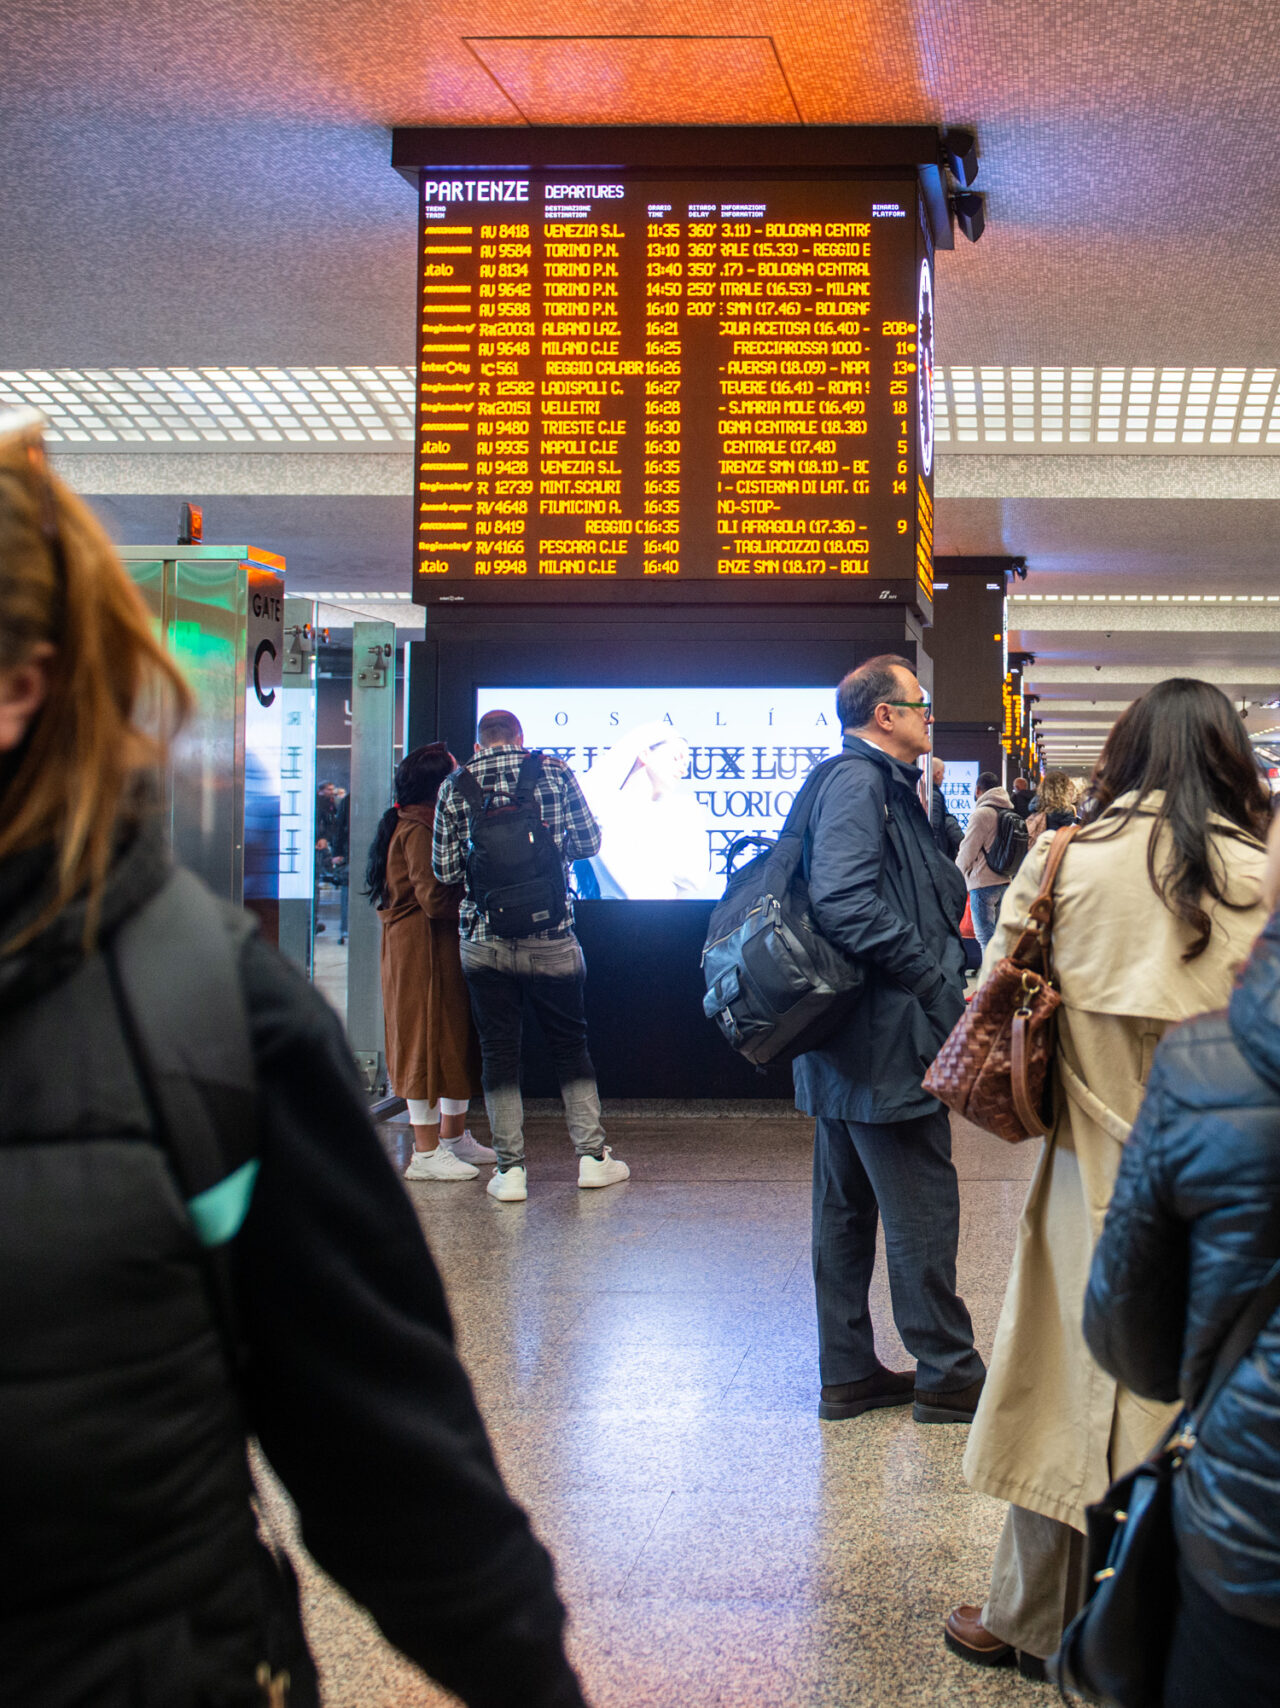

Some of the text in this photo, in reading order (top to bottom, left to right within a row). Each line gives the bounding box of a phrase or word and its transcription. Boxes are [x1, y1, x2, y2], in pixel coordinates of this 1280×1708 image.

[425, 181, 625, 201] PARTENZE DEPARTURES
[498, 223, 822, 238] 8418 VENEZIA S.L. 11:35 360' BOLOGNA
[500, 243, 860, 257] 9584 TORINO P.N. 13:10 360' (15.33) REGGIO
[498, 263, 529, 277] 8134
[544, 263, 590, 277] TORINO
[593, 263, 619, 277] P.N.
[647, 263, 683, 277] 13:40
[688, 263, 717, 277] 350'
[757, 263, 814, 277] BOLOGNA
[498, 282, 812, 297] 9642 TORINO P.N. 14:50 250' (16.53)
[497, 302, 802, 316] 9588 TORINO P.N. 16:10 200' SMN (17.46)
[496, 322, 907, 336] 20031 ALBANO LAZ. 16:21 ACETOSA (16.40) 20B
[496, 341, 907, 355] 9648 MILANO C.LE 16:25 FRECCIAROSSA 1000 11
[496, 361, 907, 375] 561 REGGIO 16:26 AVERSA (18.09) 13
[496, 381, 908, 395] 12582 LADISPOLI 16:27 TEVERE (16.41) ROMA 25
[495, 401, 908, 415] 20151 VELLETRI 16:28 S.MARIA MOLE (16.49) 18
[495, 420, 908, 435] 9480 TRIESTE C.LE 16:30 CENTRALE (18.38) 1
[495, 440, 529, 455] 9935
[541, 440, 587, 455] NAPOLI
[589, 440, 618, 455] C.LE
[645, 440, 681, 455] 16:30
[723, 440, 787, 455] CENTRALE
[790, 440, 836, 455] (17.48)
[897, 440, 908, 455] 5
[494, 460, 907, 475] 9428 VENEZIA S.L. 16:35 SMN (18.11) 6
[494, 480, 907, 494] 12739 MINT.SCAURI 16:35 CISTERNA DI LAT. 14
[494, 500, 529, 514] 4648
[540, 500, 606, 514] FIUMICINO
[644, 500, 680, 514] 16:35
[494, 520, 907, 535] 8419 REGGIO 16:35 AFRAGOLA (17.36) 9
[493, 540, 870, 554] 4166 PESCARA C.LE 16:40 TAGLIACOZZO (18.05)
[493, 560, 528, 574] 9948
[539, 560, 586, 574] MILANO
[588, 560, 617, 574] C.LE
[643, 560, 679, 574] 16:40
[753, 560, 780, 574] SMN
[782, 560, 827, 574] (18.17)
[252, 593, 280, 622] GATE
[254, 639, 277, 708] C
